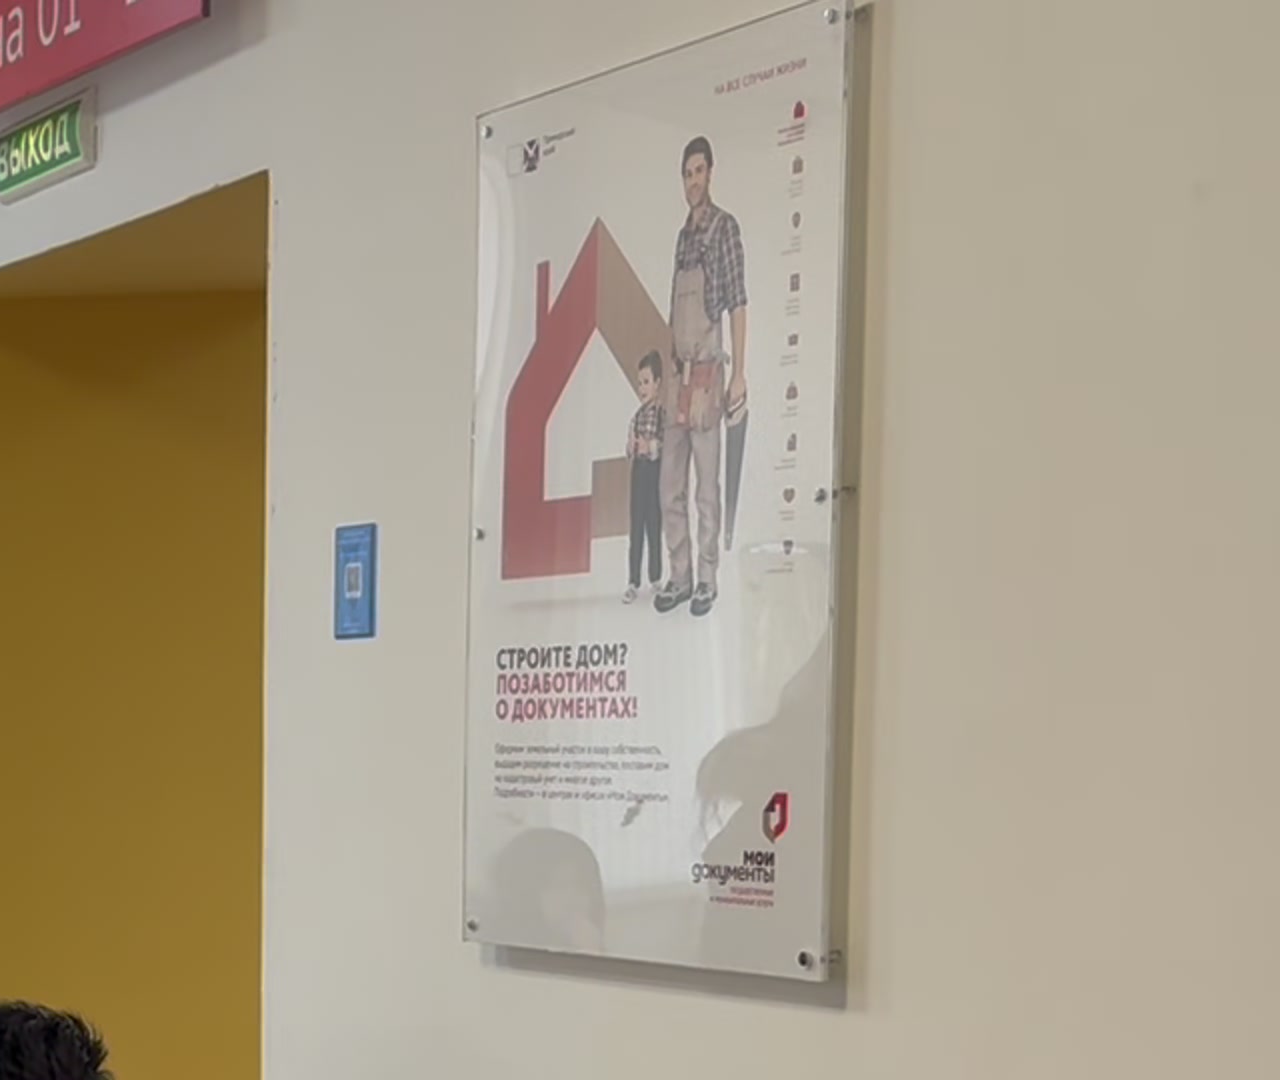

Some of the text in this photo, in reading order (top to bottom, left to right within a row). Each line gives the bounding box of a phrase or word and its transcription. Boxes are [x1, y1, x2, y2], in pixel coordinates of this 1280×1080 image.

[496, 643, 628, 670] СТРОИТЕ ДОМ?
[496, 670, 627, 695] ПОЗАБОТИМСЯ
[495, 696, 638, 723] О ДОКУМЕНТАХ!
